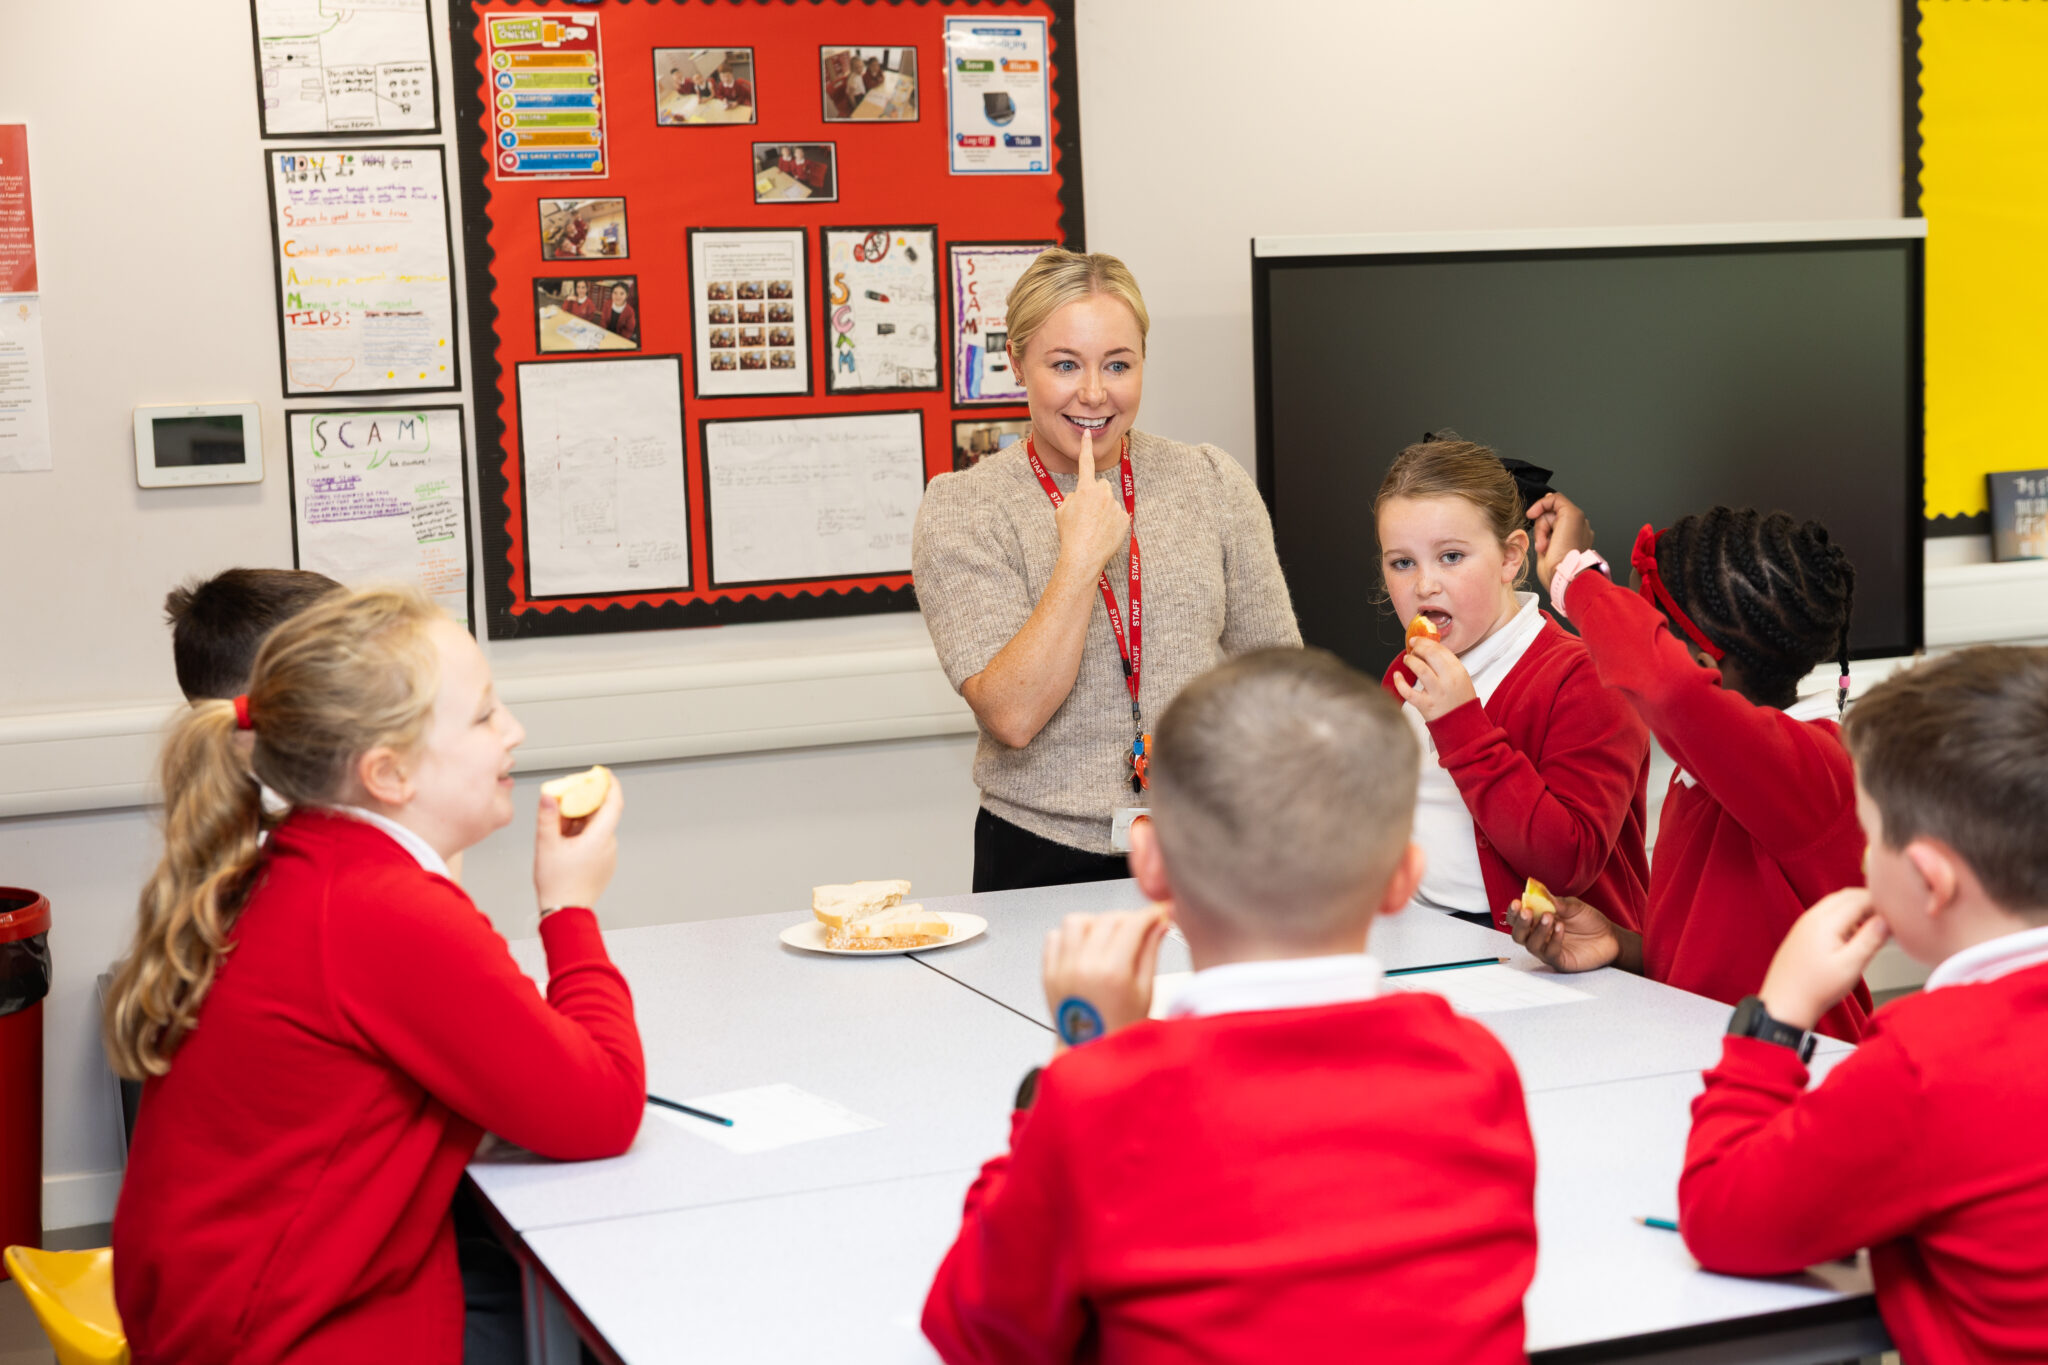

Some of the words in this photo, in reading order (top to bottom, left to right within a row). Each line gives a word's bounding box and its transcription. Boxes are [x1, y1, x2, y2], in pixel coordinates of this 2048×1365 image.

[498, 30, 537, 40] ONLINE
[500, 76, 511, 86] M
[502, 96, 511, 106] A
[504, 135, 512, 146] T
[962, 258, 981, 334] SCAM
[285, 310, 350, 327] TIPS:
[316, 420, 415, 452] SCAM
[1030, 455, 1047, 479] STAFF
[1124, 474, 1133, 497] STAFF
[1050, 491, 1063, 508] STA
[1110, 608, 1122, 636] STAFF
